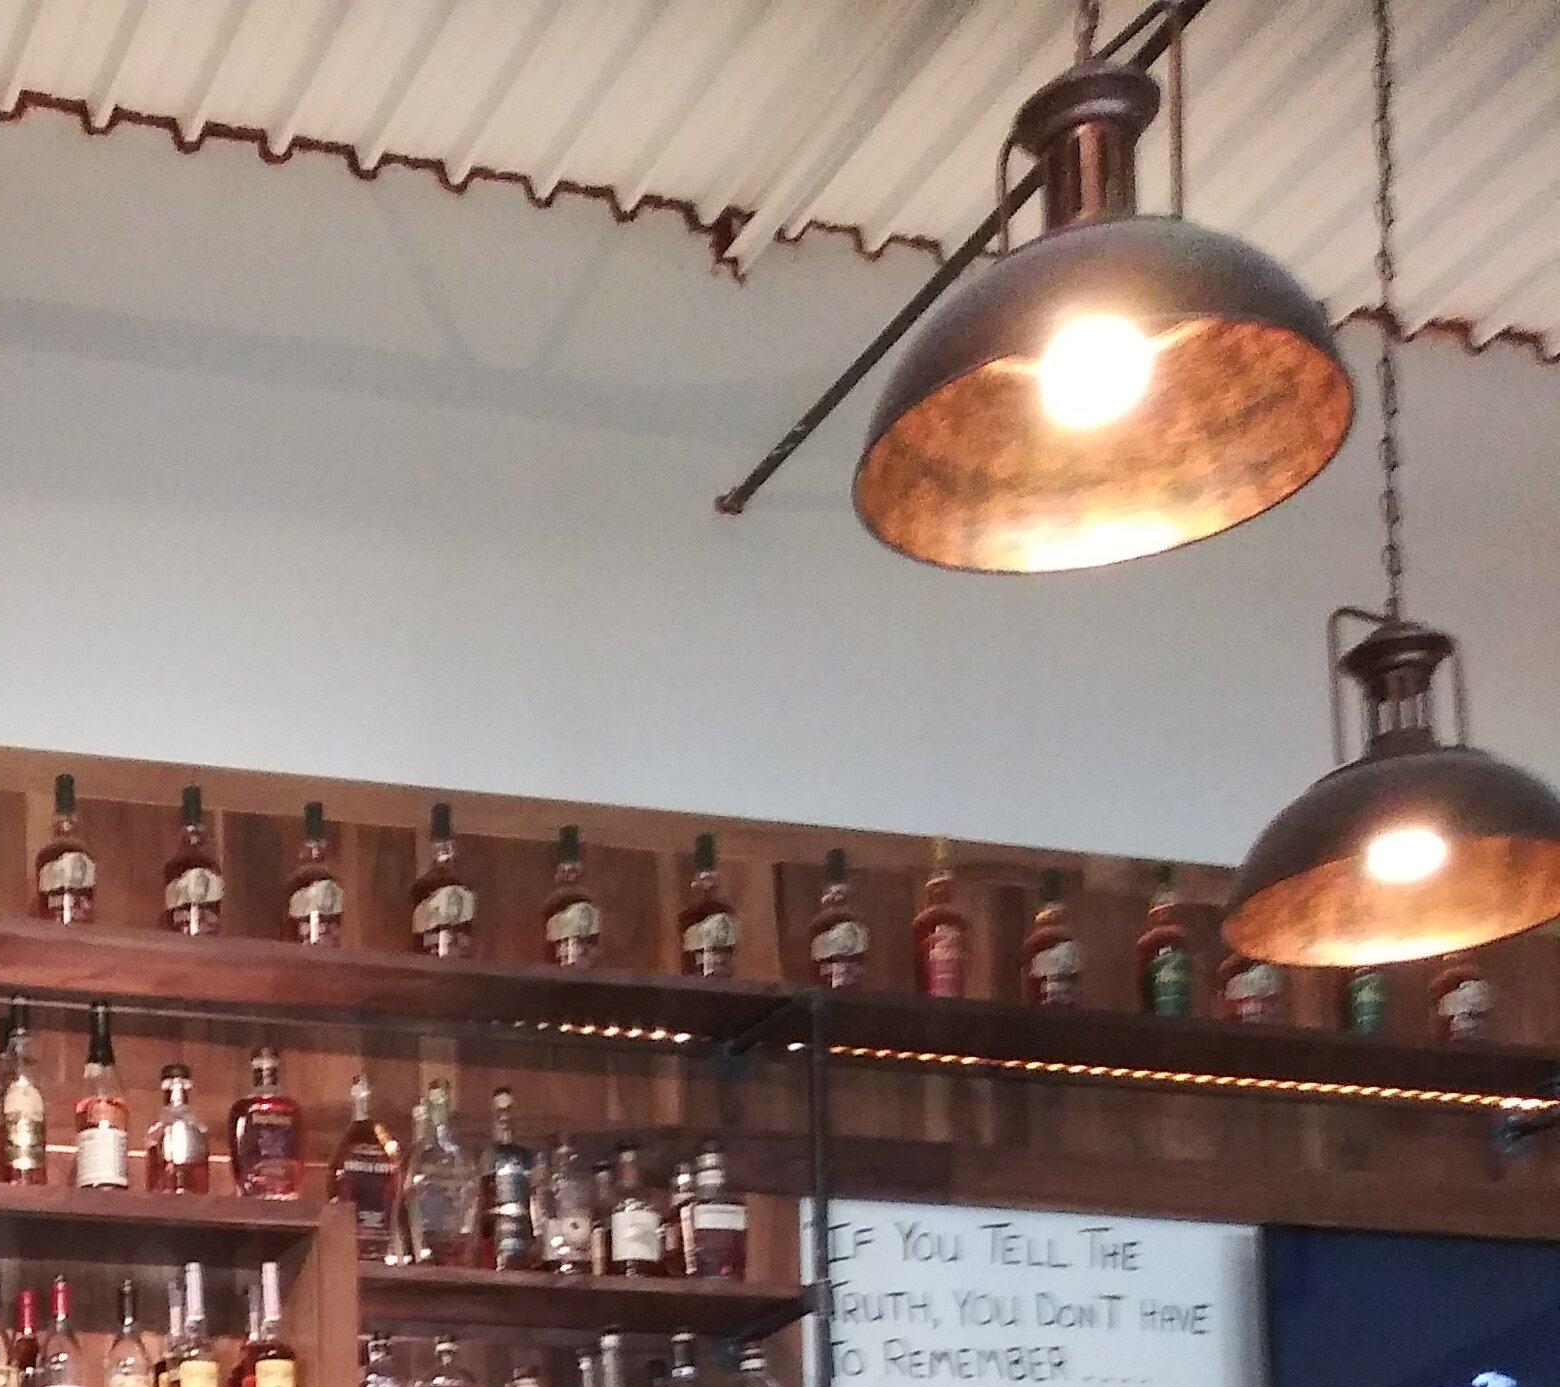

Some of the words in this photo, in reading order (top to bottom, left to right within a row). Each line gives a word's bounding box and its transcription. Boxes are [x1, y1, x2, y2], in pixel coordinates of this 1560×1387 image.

[828, 1221, 874, 1264] IF
[893, 1220, 962, 1262] YOU
[980, 1221, 1072, 1270] TELL
[1078, 1226, 1142, 1271] THE
[952, 1289, 1020, 1327] YOU
[1140, 1299, 1216, 1336] HAVE
